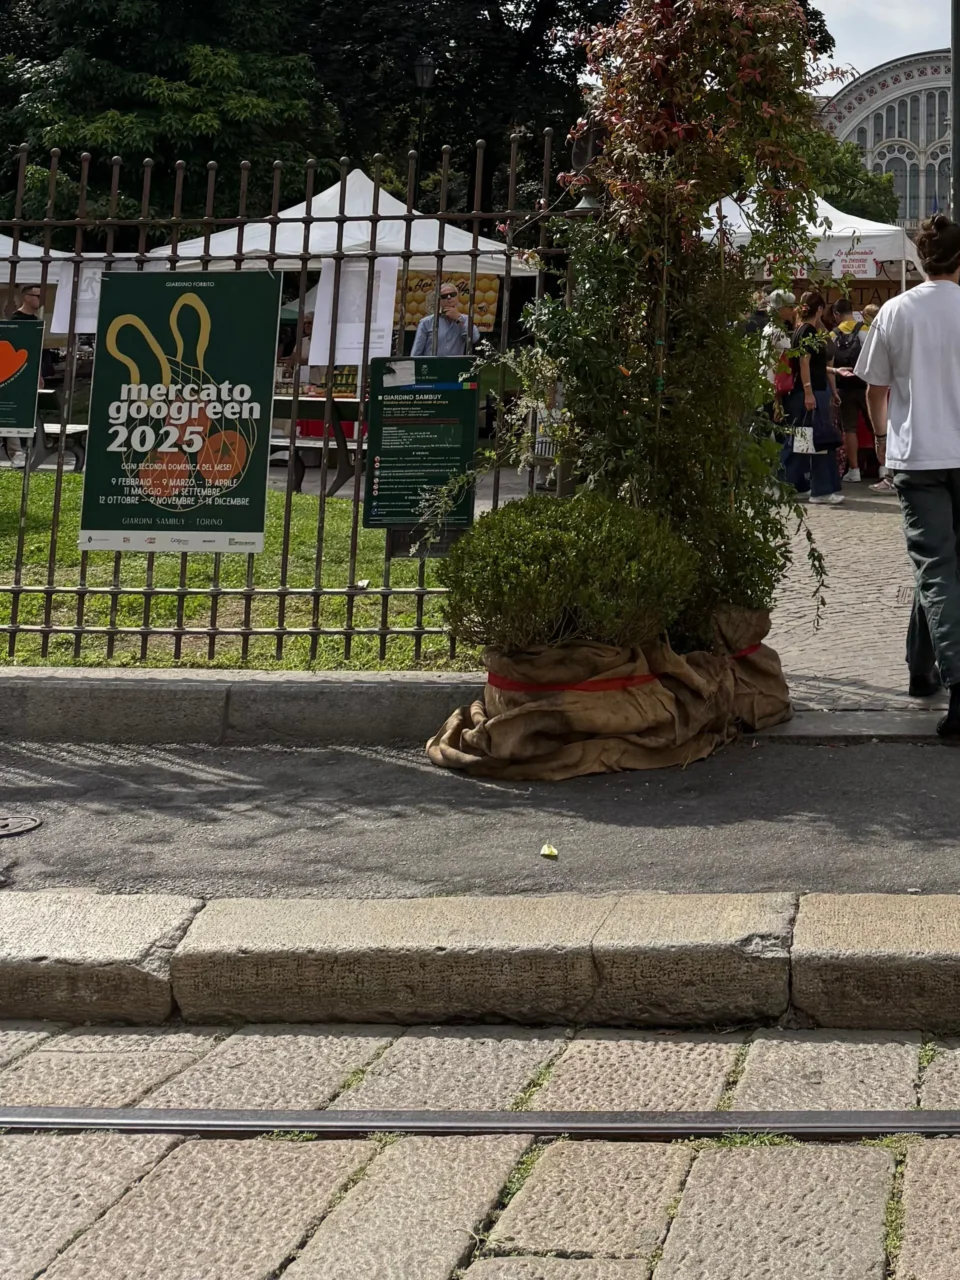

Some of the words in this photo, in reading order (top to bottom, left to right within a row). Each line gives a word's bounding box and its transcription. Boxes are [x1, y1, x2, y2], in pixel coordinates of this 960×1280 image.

[120, 380, 252, 402] mercato
[108, 400, 261, 425] googreen
[106, 425, 204, 453] 2025
[168, 463, 200, 471] DOMENICA
[201, 463, 213, 471] DEL
[111, 478, 117, 486] 9
[118, 478, 152, 486] FEBBRAIO
[162, 478, 167, 486] 9
[169, 478, 196, 487] MARZO
[205, 479, 212, 487] 13
[214, 479, 238, 487] APRILE
[123, 487, 130, 495] 11
[131, 487, 162, 496] MAGGIO
[172, 487, 179, 496] 14
[181, 488, 221, 496] SETTEMBRE
[99, 496, 105, 504] 12
[107, 496, 140, 504] OTTOBRE
[149, 497, 155, 505] 9
[156, 496, 195, 505] NOVEMBRE
[205, 497, 213, 505] 14
[214, 497, 250, 506] DICEMBRE
[122, 517, 153, 525] GIARDINI
[196, 518, 223, 526] TORINO
